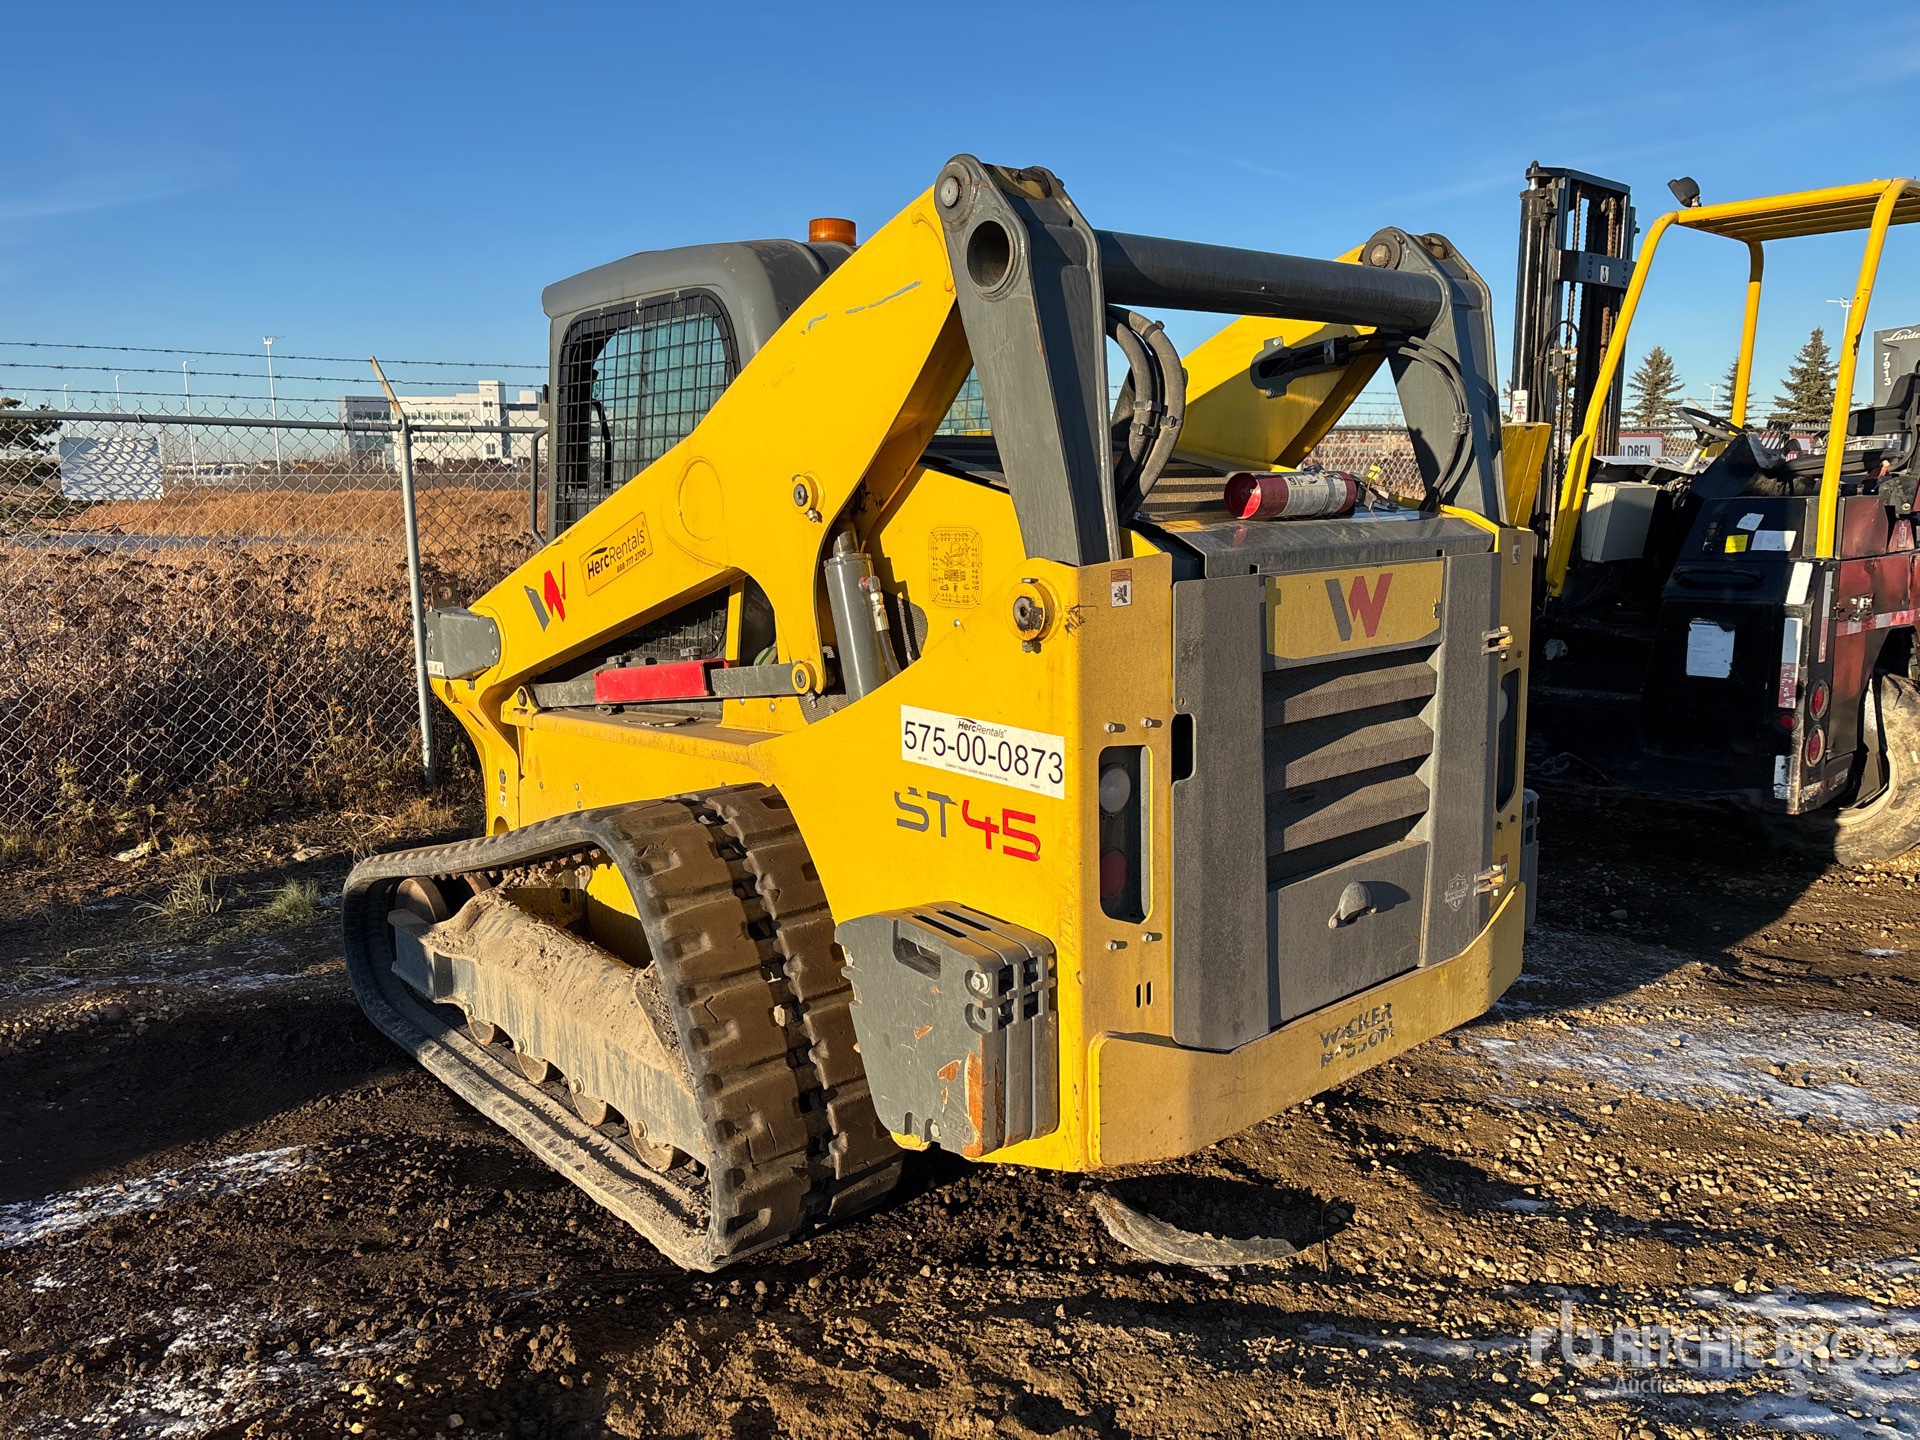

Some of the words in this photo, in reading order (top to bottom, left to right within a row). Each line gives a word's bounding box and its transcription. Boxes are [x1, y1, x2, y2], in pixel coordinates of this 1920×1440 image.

[1882, 329, 1920, 342] Linde
[1882, 352, 1892, 386] 7913
[1620, 445, 1650, 457] ILDREN
[587, 528, 645, 580] HercRentals
[904, 720, 1064, 784] 575-00-0873
